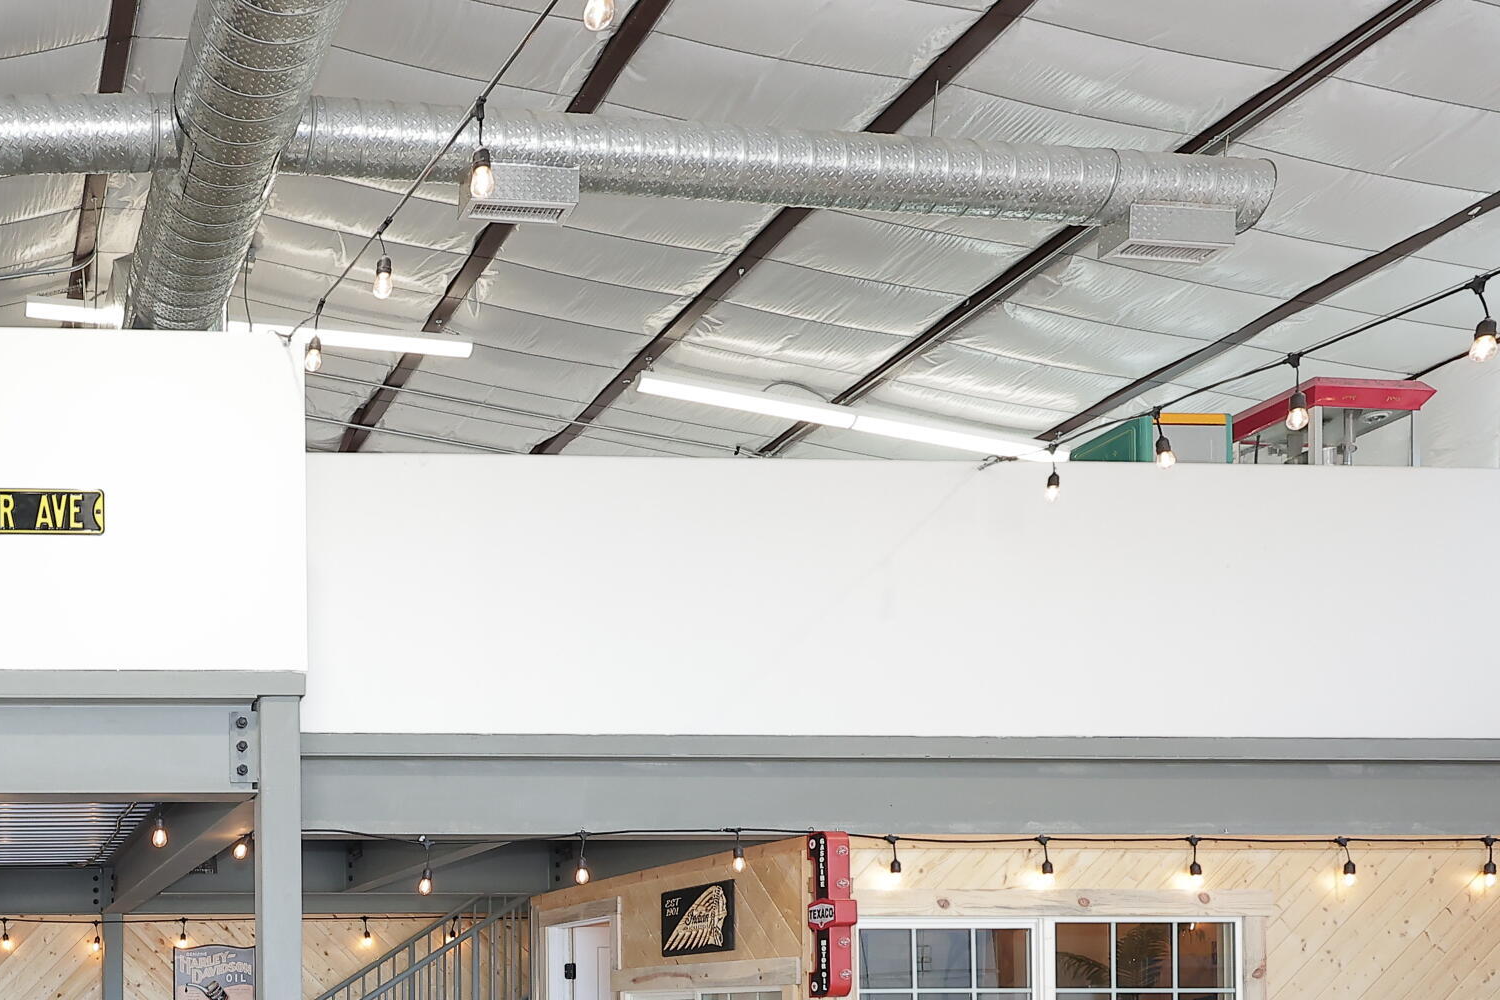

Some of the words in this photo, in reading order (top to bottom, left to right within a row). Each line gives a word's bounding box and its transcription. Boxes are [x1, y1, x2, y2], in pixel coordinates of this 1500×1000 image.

[35, 493, 84, 529] AVE
[664, 897, 682, 909] EST
[809, 907, 834, 921] TEXACO
[191, 961, 253, 985] DAVIDSON
[225, 973, 247, 983] OIL
